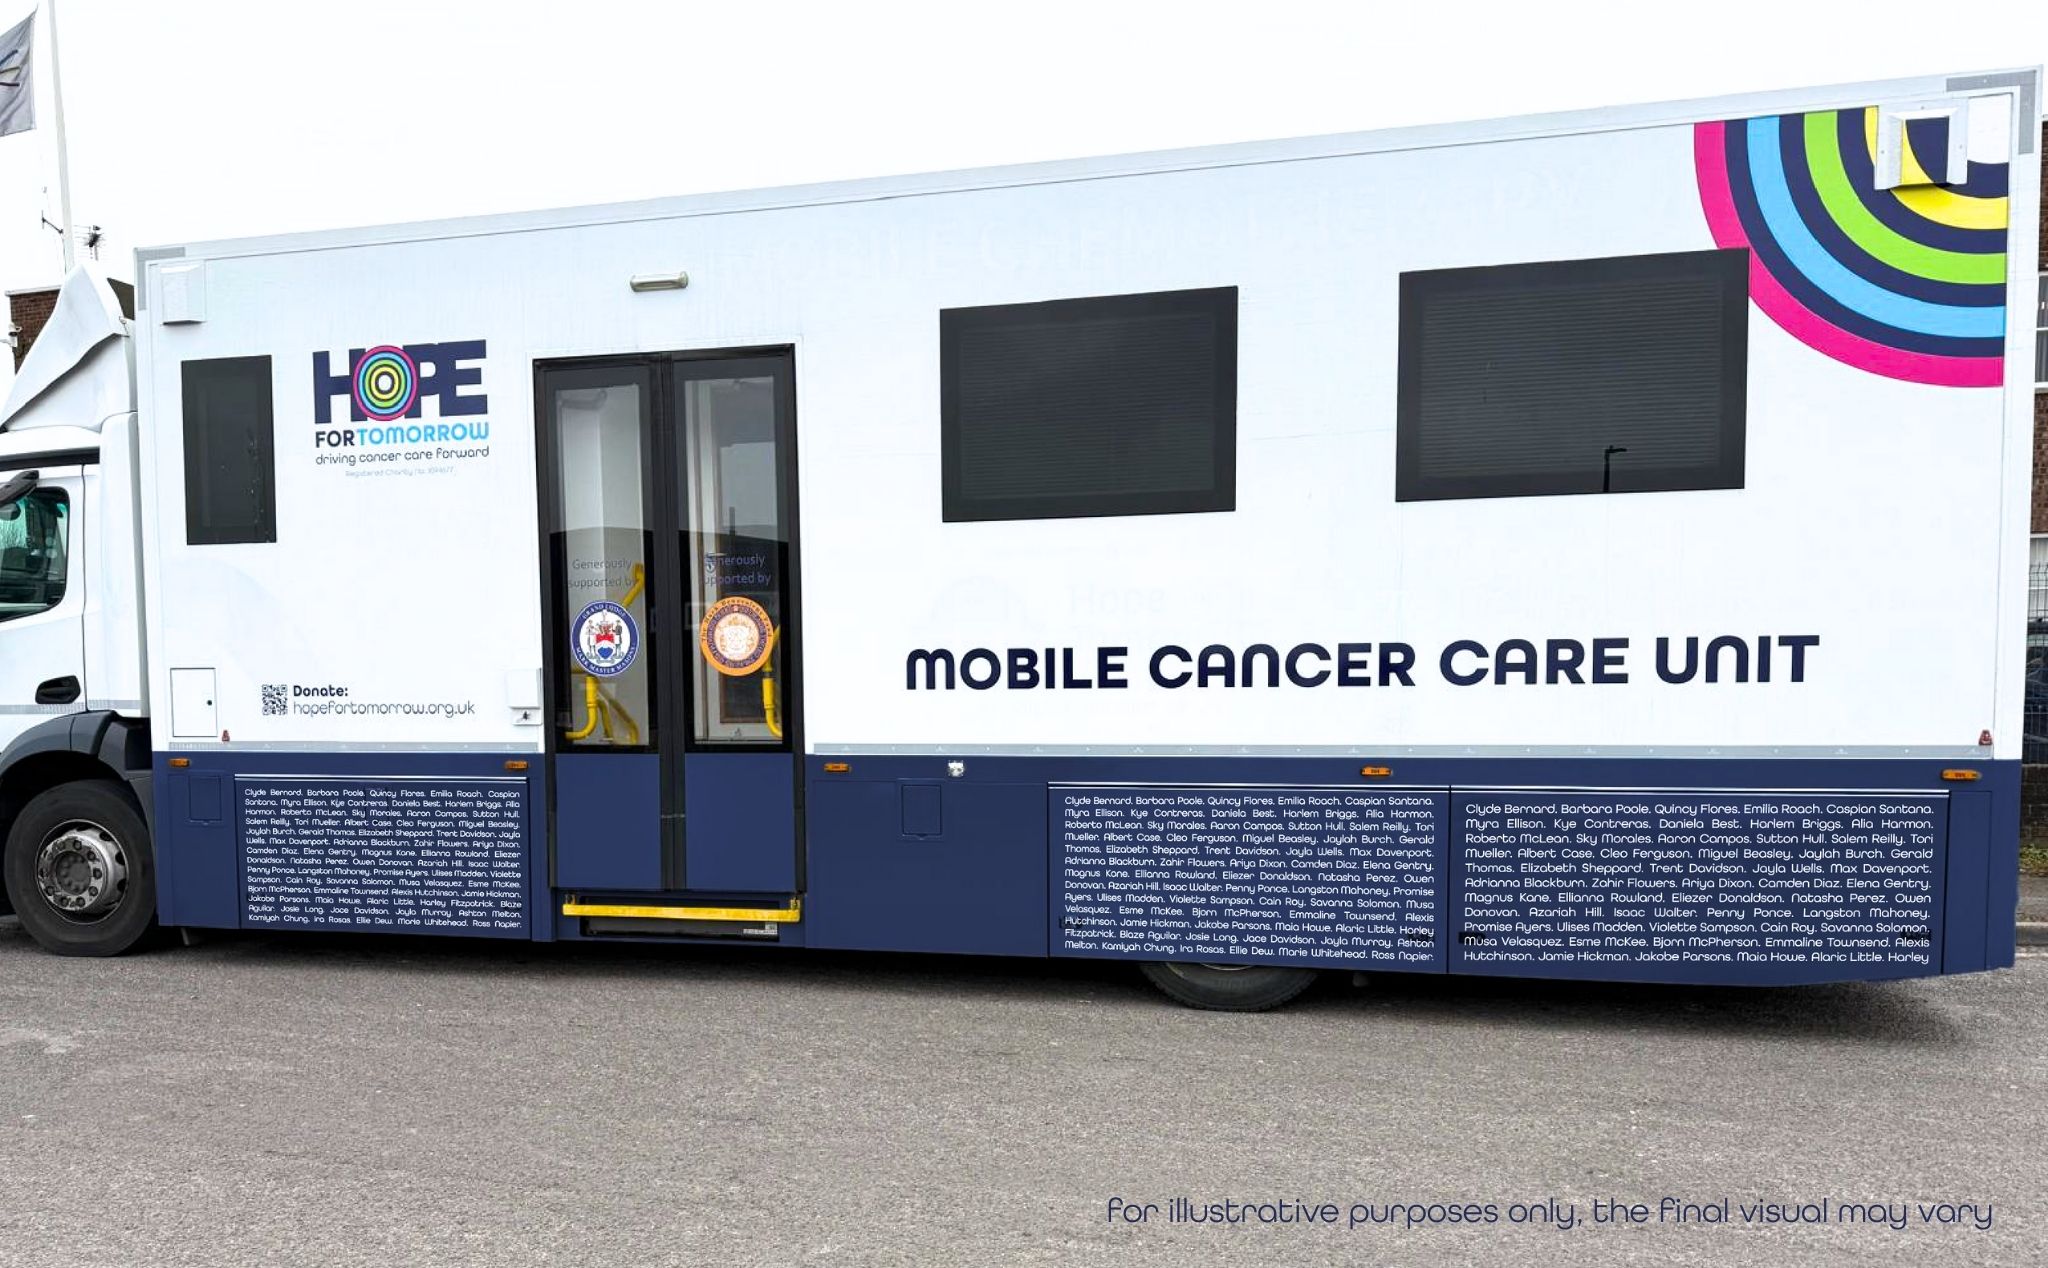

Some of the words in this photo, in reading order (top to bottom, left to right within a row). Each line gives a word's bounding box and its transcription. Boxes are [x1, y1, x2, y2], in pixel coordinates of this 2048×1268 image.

[313, 339, 488, 424] HOPE
[316, 452, 356, 467] driving
[359, 451, 402, 463] cancer
[404, 450, 433, 460] care
[436, 446, 489, 459] forward
[572, 559, 632, 570] Generously
[757, 571, 771, 586] by
[906, 646, 1128, 691] MOBILE
[1149, 642, 1416, 689] CANCER
[1439, 637, 1630, 687] CARE
[1655, 634, 1820, 684] UNIT
[293, 685, 349, 697] Donate:
[293, 700, 475, 718] hopefortomorrow.org.uk
[1465, 803, 1501, 817] Clyde
[1561, 803, 1613, 814] Barbara
[1654, 803, 1697, 817] Quincy
[1743, 803, 1778, 814] Emilia
[1826, 803, 1876, 817] Caspian
[1465, 818, 1499, 832] Myra
[1554, 818, 1576, 832] Kye
[1659, 818, 1704, 829] Daniela
[1750, 818, 1795, 829] Harlem
[1851, 818, 1873, 829] Alia
[1465, 833, 1516, 843] Roberto
[1576, 833, 1597, 847] Sky
[1657, 833, 1695, 844] Aaron
[1756, 833, 1799, 844] Sutton
[1831, 833, 1868, 844] Salem
[1910, 833, 1933, 844] Tori
[1517, 847, 1556, 858] Albert
[1600, 847, 1628, 858] Cleo
[1698, 848, 1738, 862] Miguel
[1798, 848, 1840, 862] Jaylah
[1890, 848, 1933, 859] Gerald
[1520, 862, 1576, 873] Elizabeth
[1649, 862, 1684, 873] Trent
[1752, 862, 1786, 877] Jayla
[1830, 863, 1858, 873] Max
[1464, 877, 1520, 888] Adrianna
[1591, 877, 1624, 888] Zahir
[1681, 877, 1715, 891] Ariya
[1758, 877, 1810, 888] Camden
[1846, 877, 1880, 888] Elena
